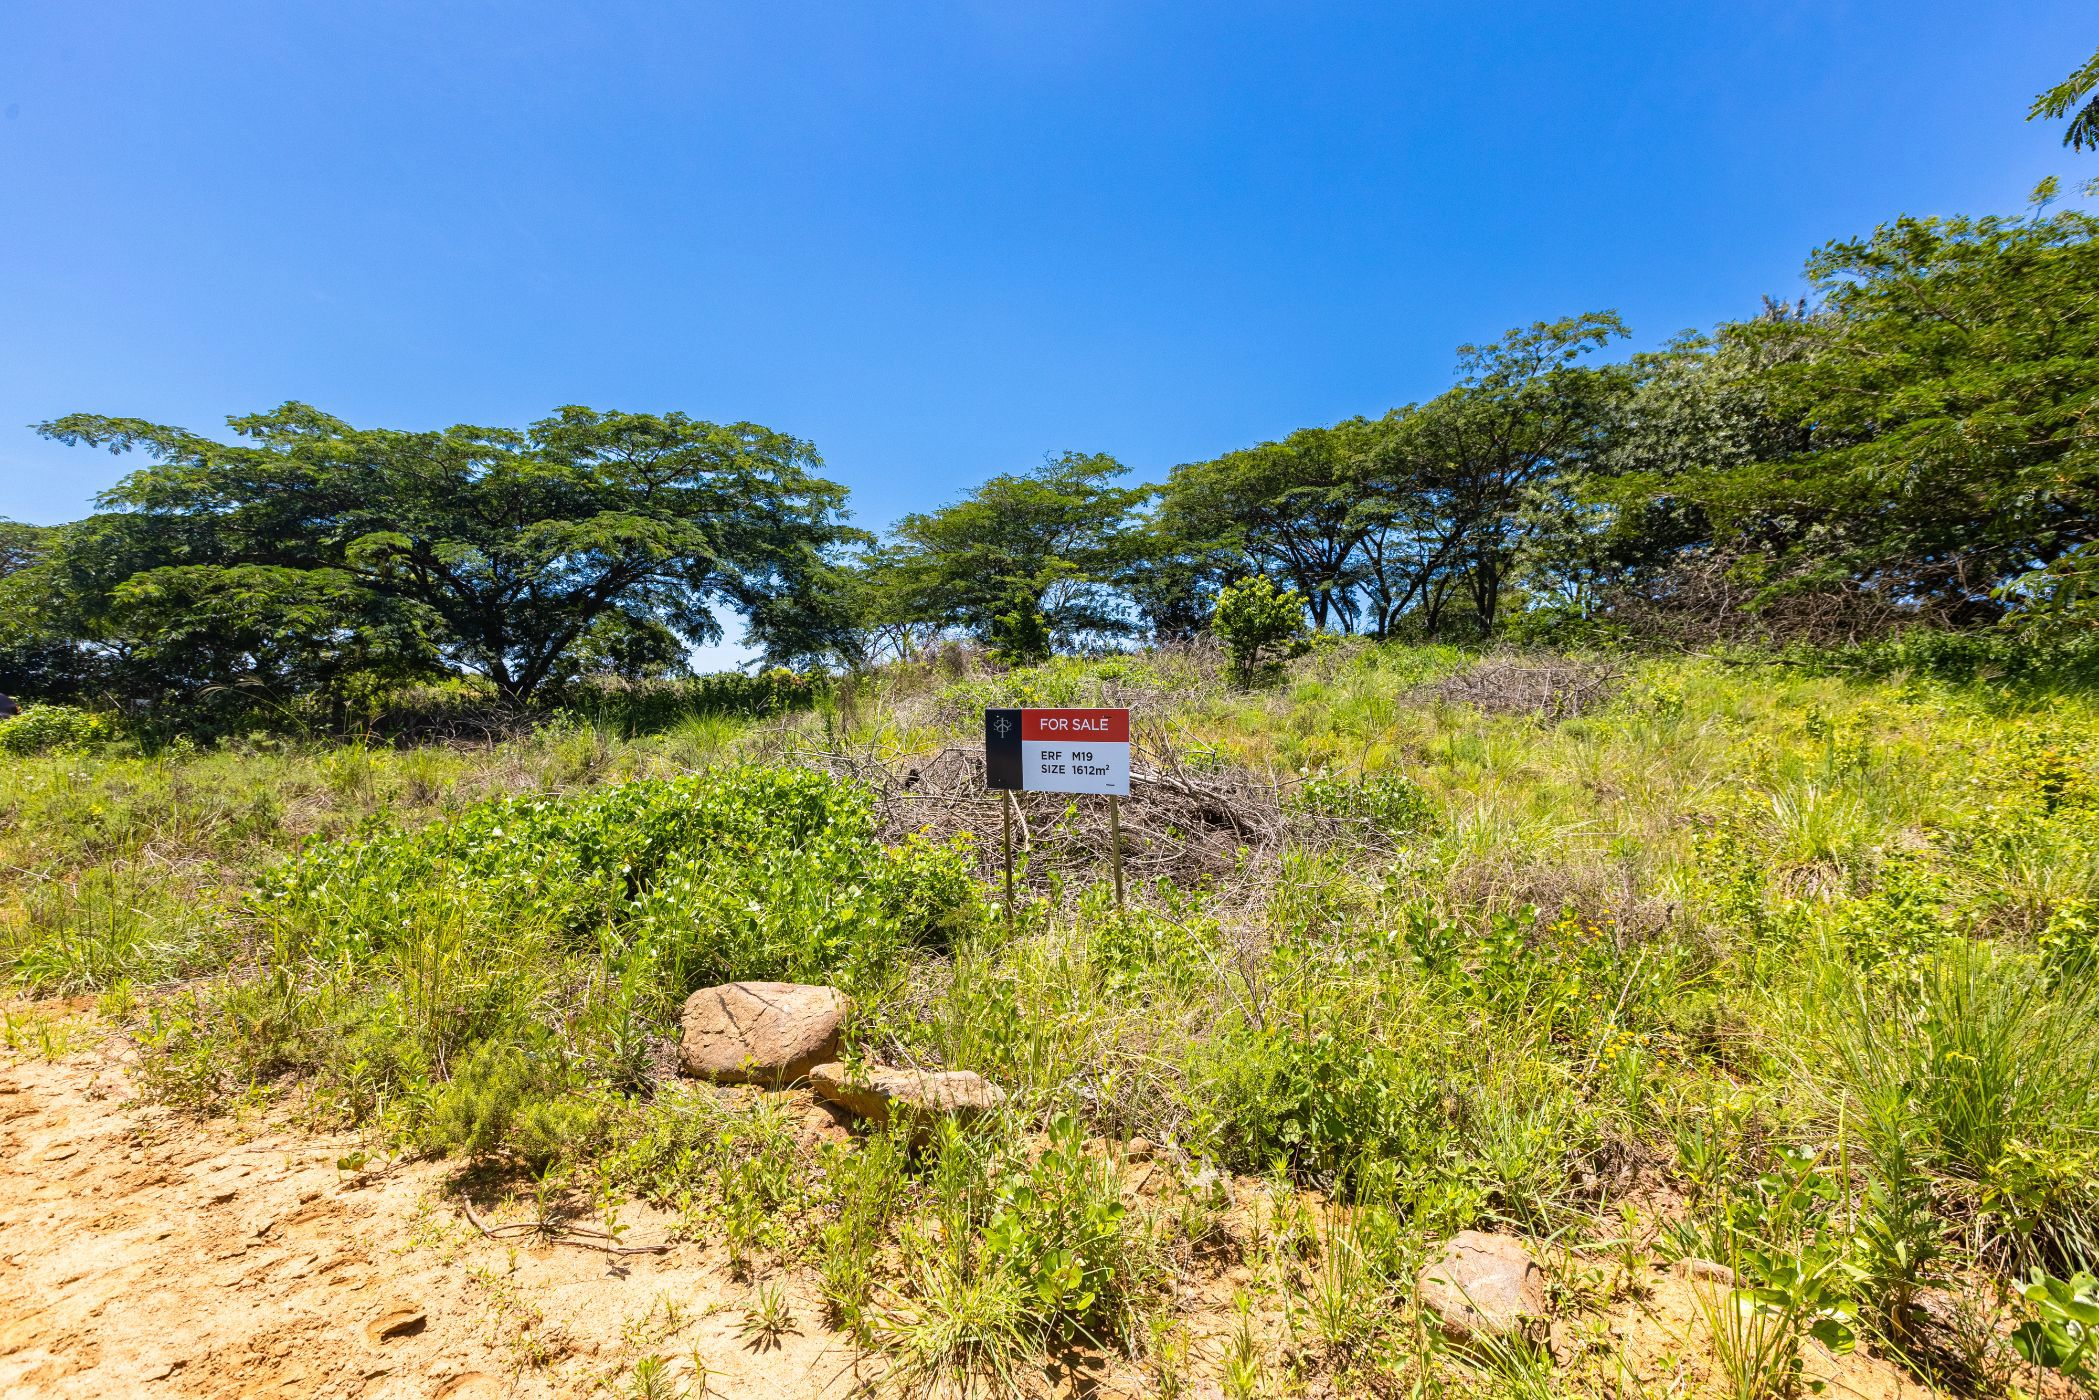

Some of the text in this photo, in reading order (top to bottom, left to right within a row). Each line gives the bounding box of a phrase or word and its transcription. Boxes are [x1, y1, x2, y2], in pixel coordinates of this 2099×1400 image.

[1040, 718, 1109, 731] FOR SALE
[1041, 751, 1093, 762] ERF M19
[1041, 764, 1110, 776] SIZE 1612m²
